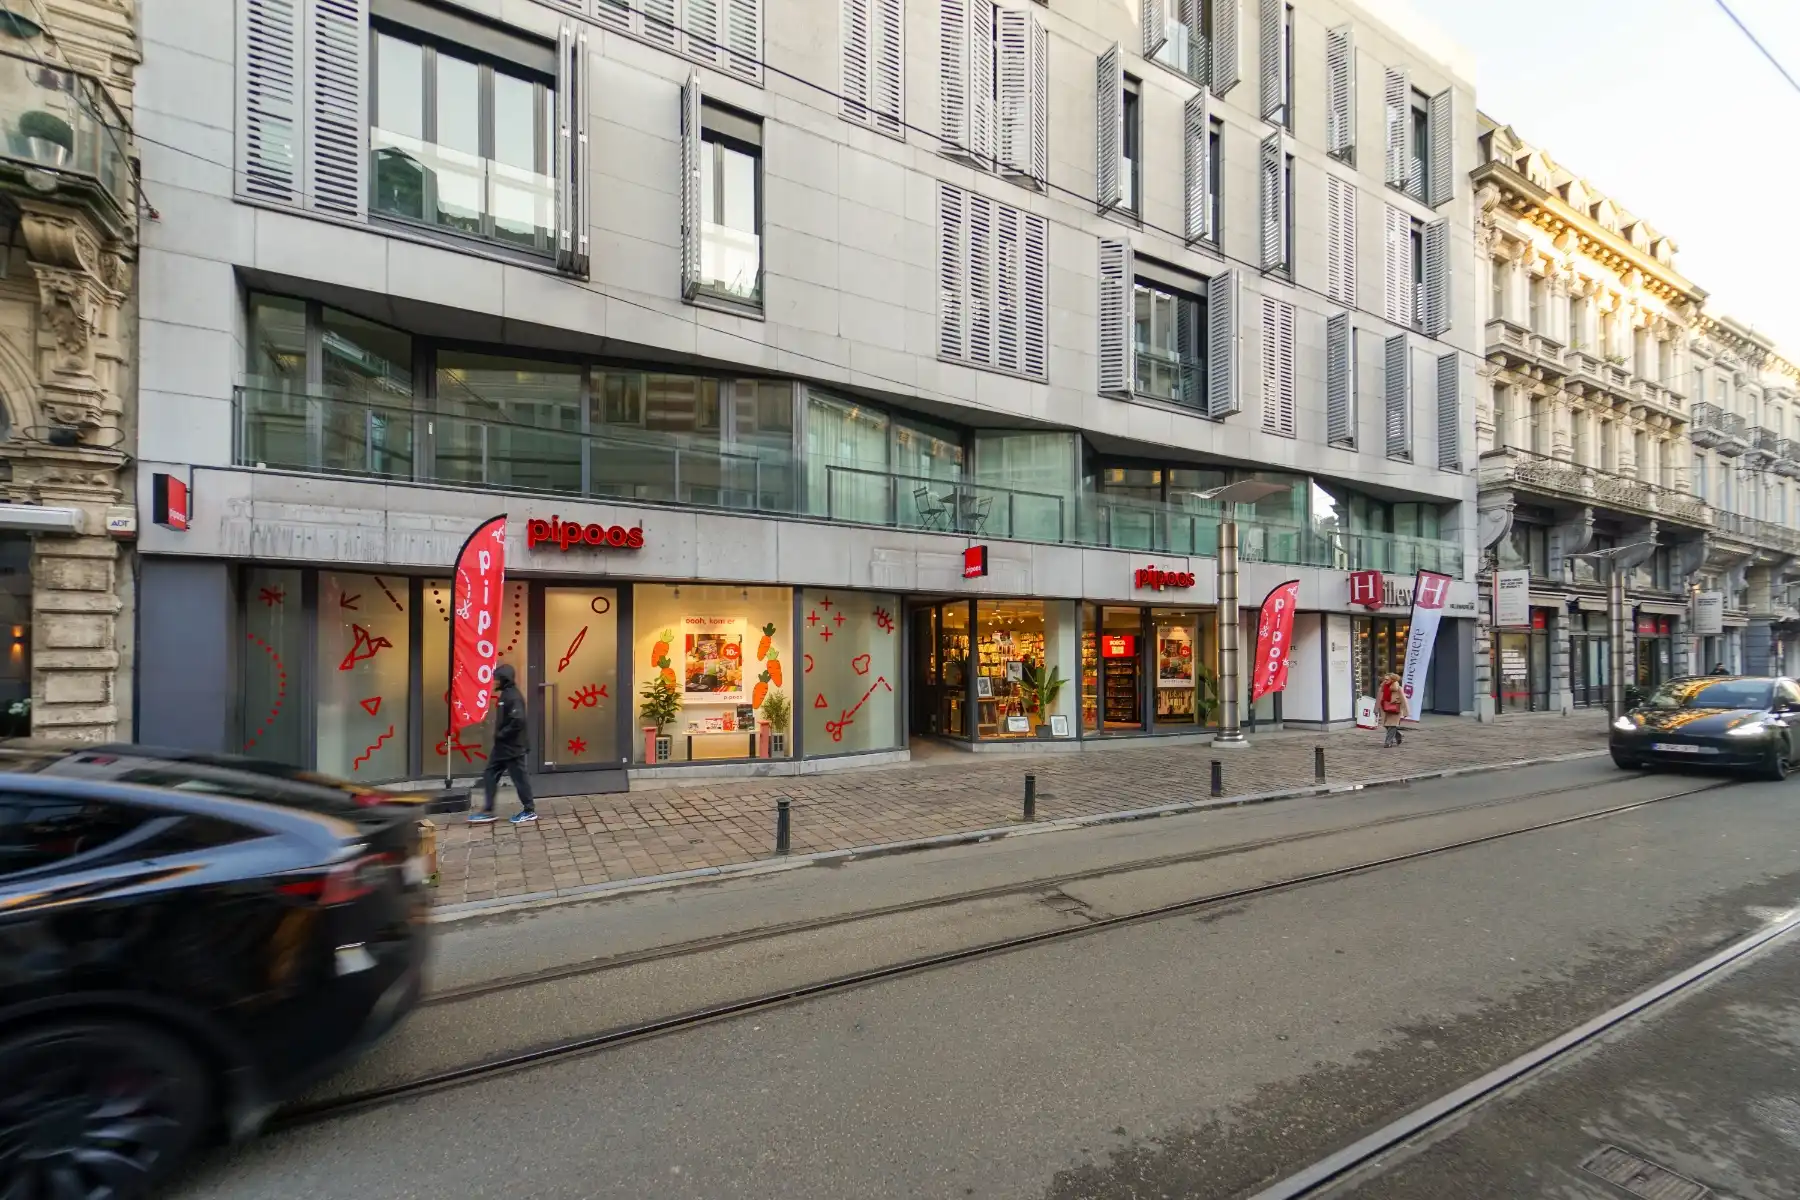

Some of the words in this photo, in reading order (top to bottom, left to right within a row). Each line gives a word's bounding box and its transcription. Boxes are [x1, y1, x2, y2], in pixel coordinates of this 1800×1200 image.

[110, 520, 130, 528] ADT
[526, 514, 645, 551] pipoos
[1135, 565, 1196, 590] pipoos
[476, 550, 494, 708] pipoos
[1267, 598, 1285, 686] pipoos
